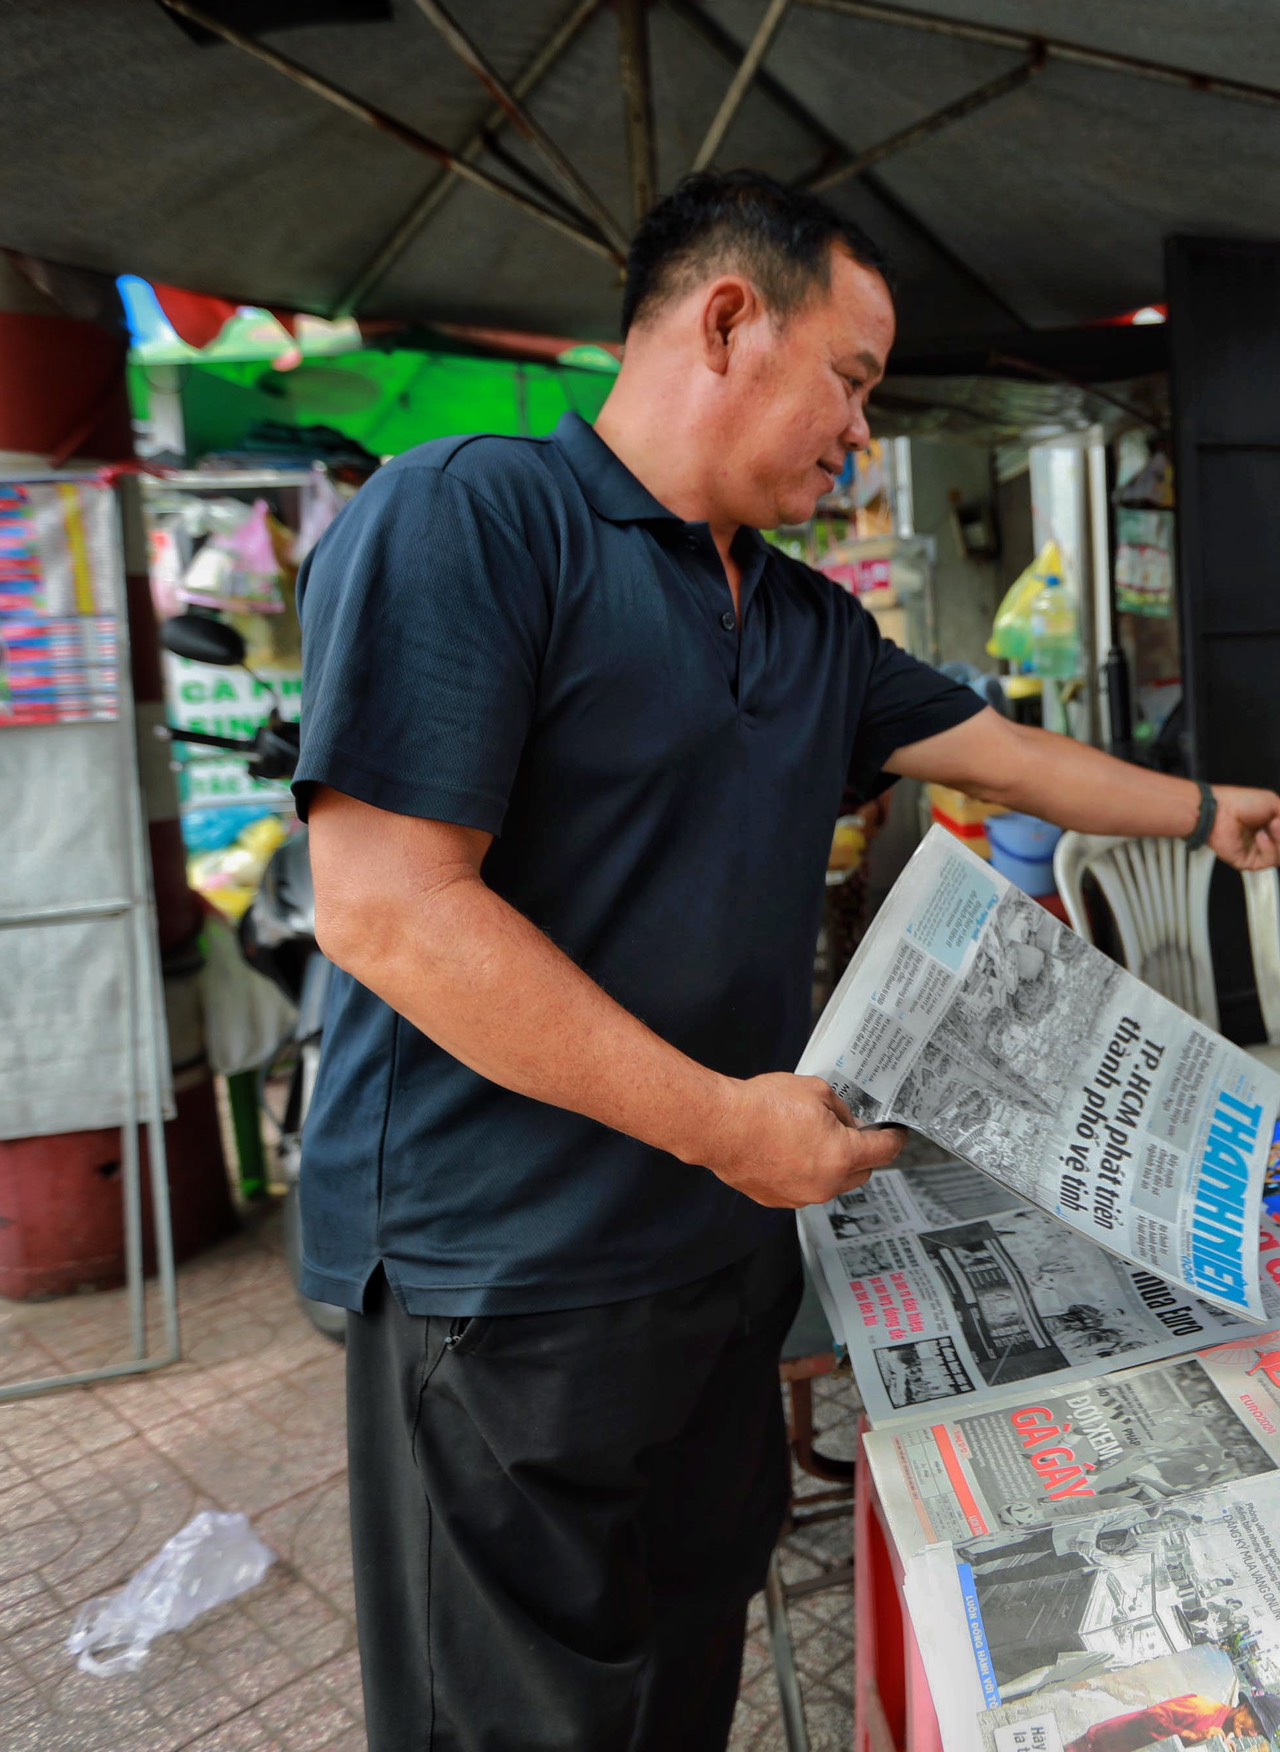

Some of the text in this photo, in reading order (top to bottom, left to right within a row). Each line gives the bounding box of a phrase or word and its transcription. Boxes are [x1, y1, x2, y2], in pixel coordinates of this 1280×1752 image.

[1114, 1030, 1166, 1137] TP.HCM
[1055, 1009, 1143, 1217] thành phố vệ tinh
[1089, 1121, 1135, 1190] phát
[1090, 1183, 1130, 1238] triển
[1156, 1306, 1203, 1337] Euro
[1010, 1406, 1073, 1449] GÀ
[1066, 1394, 1124, 1461] ĐỢI XEM
[1031, 1446, 1097, 1501] GÁY
[1222, 1513, 1245, 1538] ĐĂNG
[1243, 1501, 1261, 1522] Phóng
[1253, 1521, 1268, 1536] viên
[1233, 1504, 1251, 1524] điểm
[1246, 1532, 1264, 1553] nhưng
[1262, 1562, 1280, 1582] không
[1234, 1536, 1252, 1550] KÝ
[1240, 1549, 1261, 1571] MUA
[1260, 1534, 1274, 1548] Báo
[1250, 1568, 1274, 1594] VÀNG
[965, 1595, 978, 1621] LUÔN
[977, 1651, 990, 1679] HÀNH
